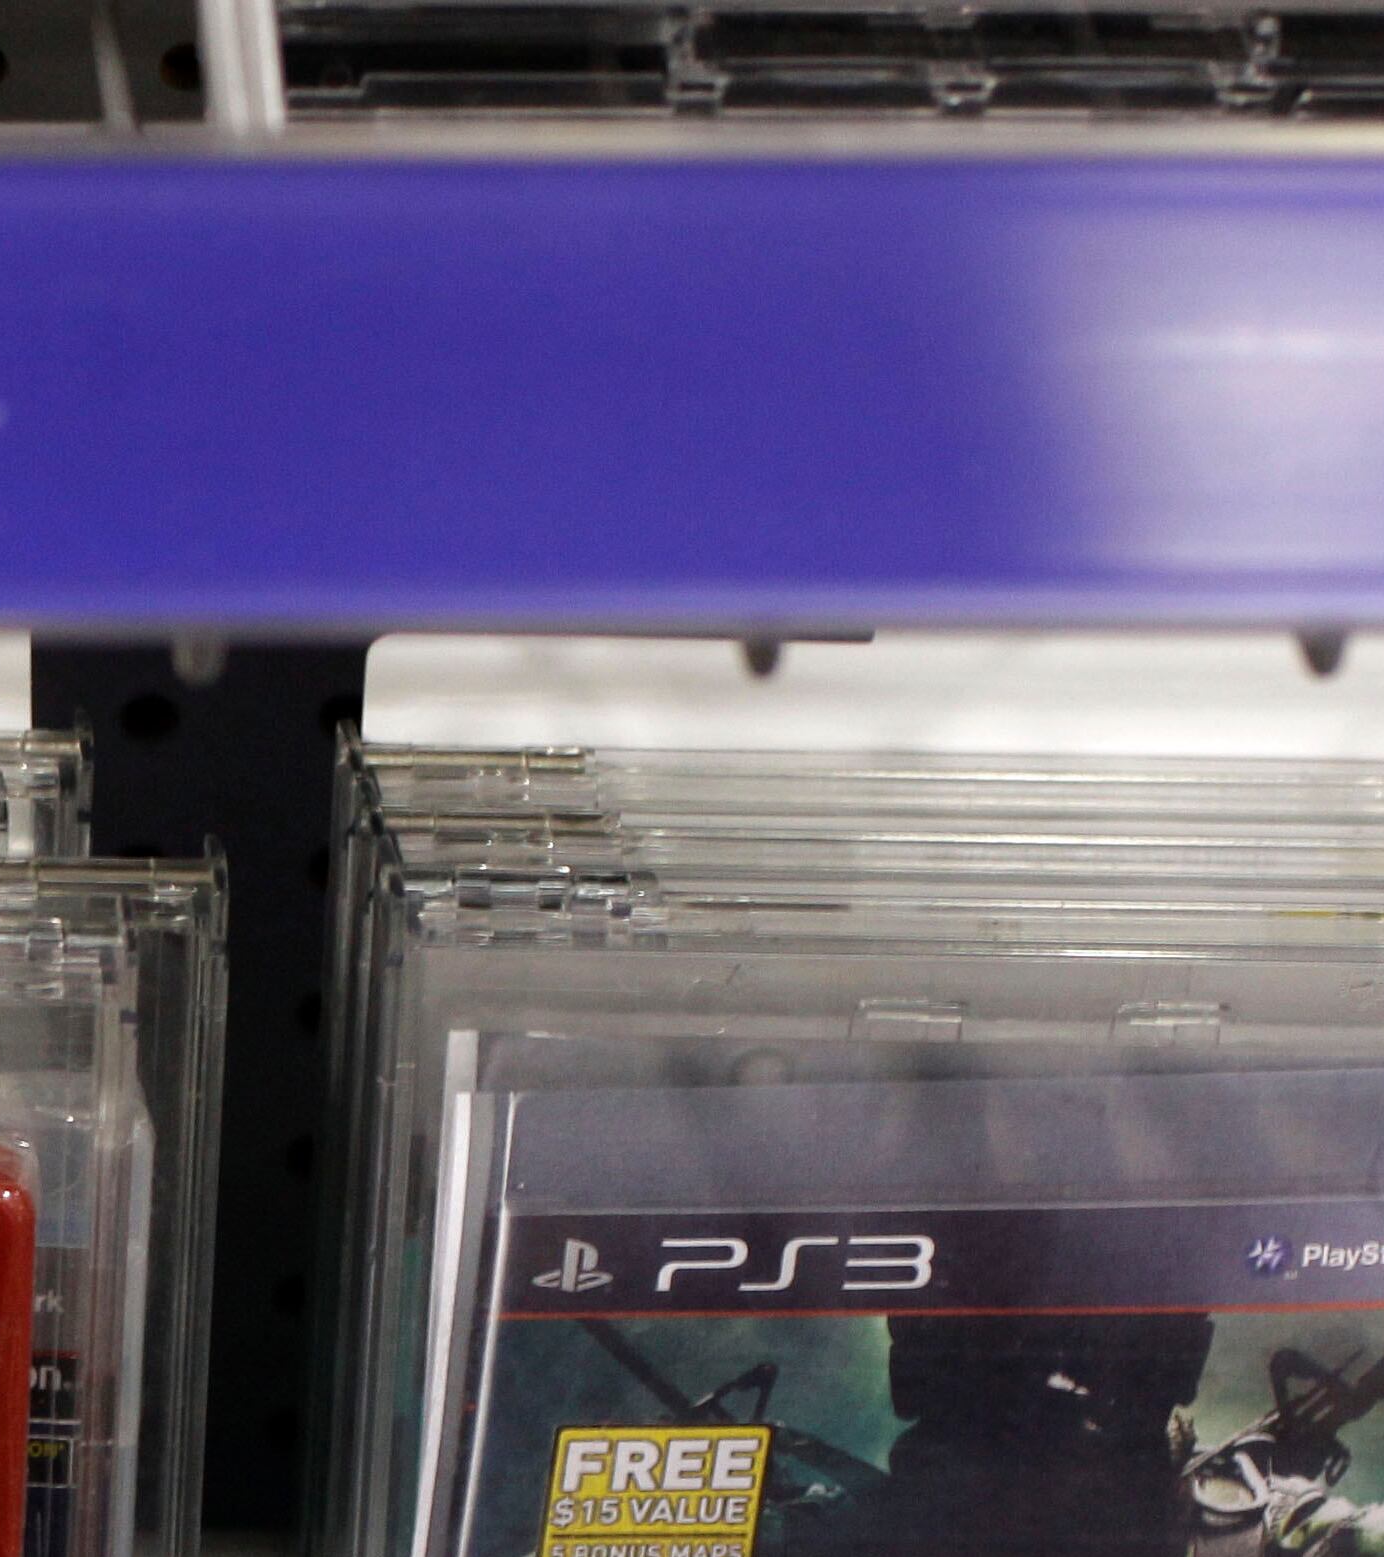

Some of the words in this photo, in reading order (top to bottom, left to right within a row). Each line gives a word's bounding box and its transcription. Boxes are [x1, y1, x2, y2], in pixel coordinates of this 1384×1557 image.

[656, 1235, 935, 1292] PS3
[562, 1438, 759, 1492] FREE
[631, 1497, 748, 1524] VALUE
